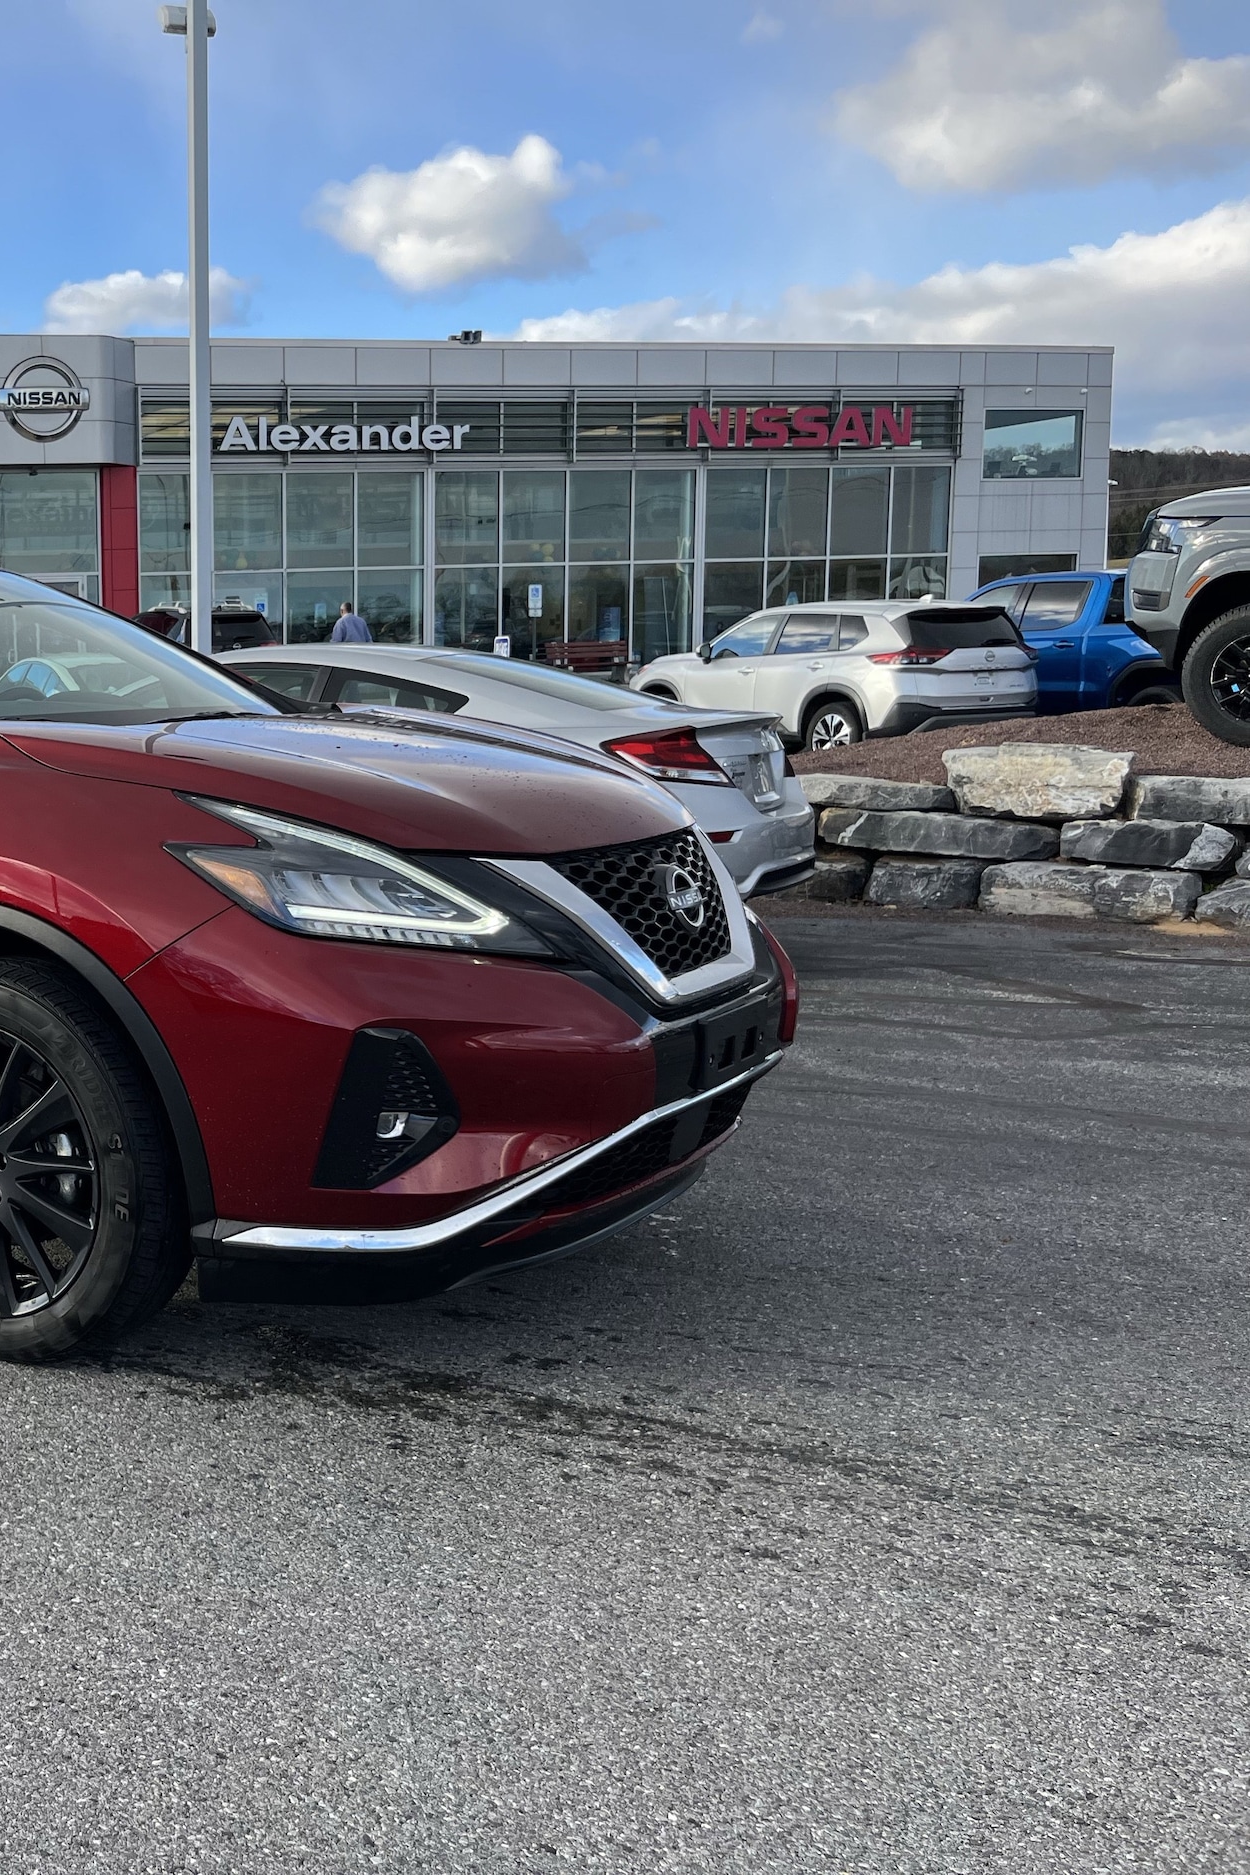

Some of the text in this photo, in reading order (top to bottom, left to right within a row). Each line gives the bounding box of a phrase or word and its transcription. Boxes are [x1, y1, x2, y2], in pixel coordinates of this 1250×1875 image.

[7, 391, 81, 406] NISSAN
[219, 416, 470, 451] Alexander
[686, 406, 913, 449] NISSAN
[670, 891, 702, 908] NISS
